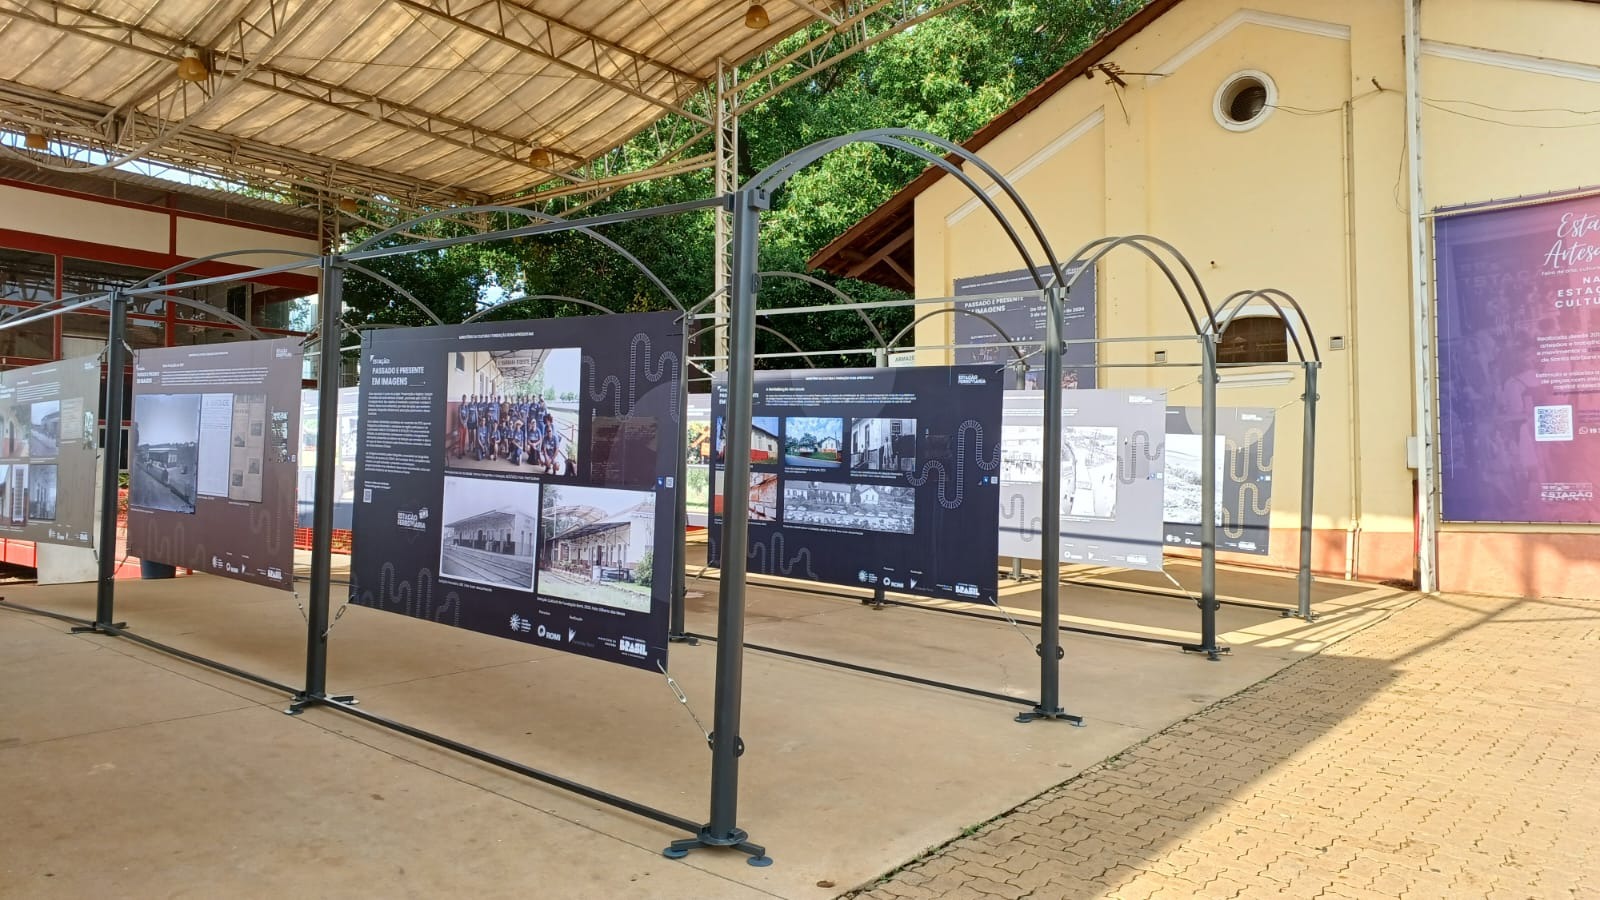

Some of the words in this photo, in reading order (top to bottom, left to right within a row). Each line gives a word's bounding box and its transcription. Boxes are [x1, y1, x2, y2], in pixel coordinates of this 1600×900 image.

[1583, 276, 1600, 284] NA
[965, 300, 991, 308] PASSADO
[372, 367, 395, 375] PASSADO
[400, 366, 425, 374] PRESENTE
[371, 377, 381, 386] EM
[382, 376, 408, 385] IMAGENS
[545, 631, 562, 642] ROMI
[619, 639, 648, 657] BRASIL
